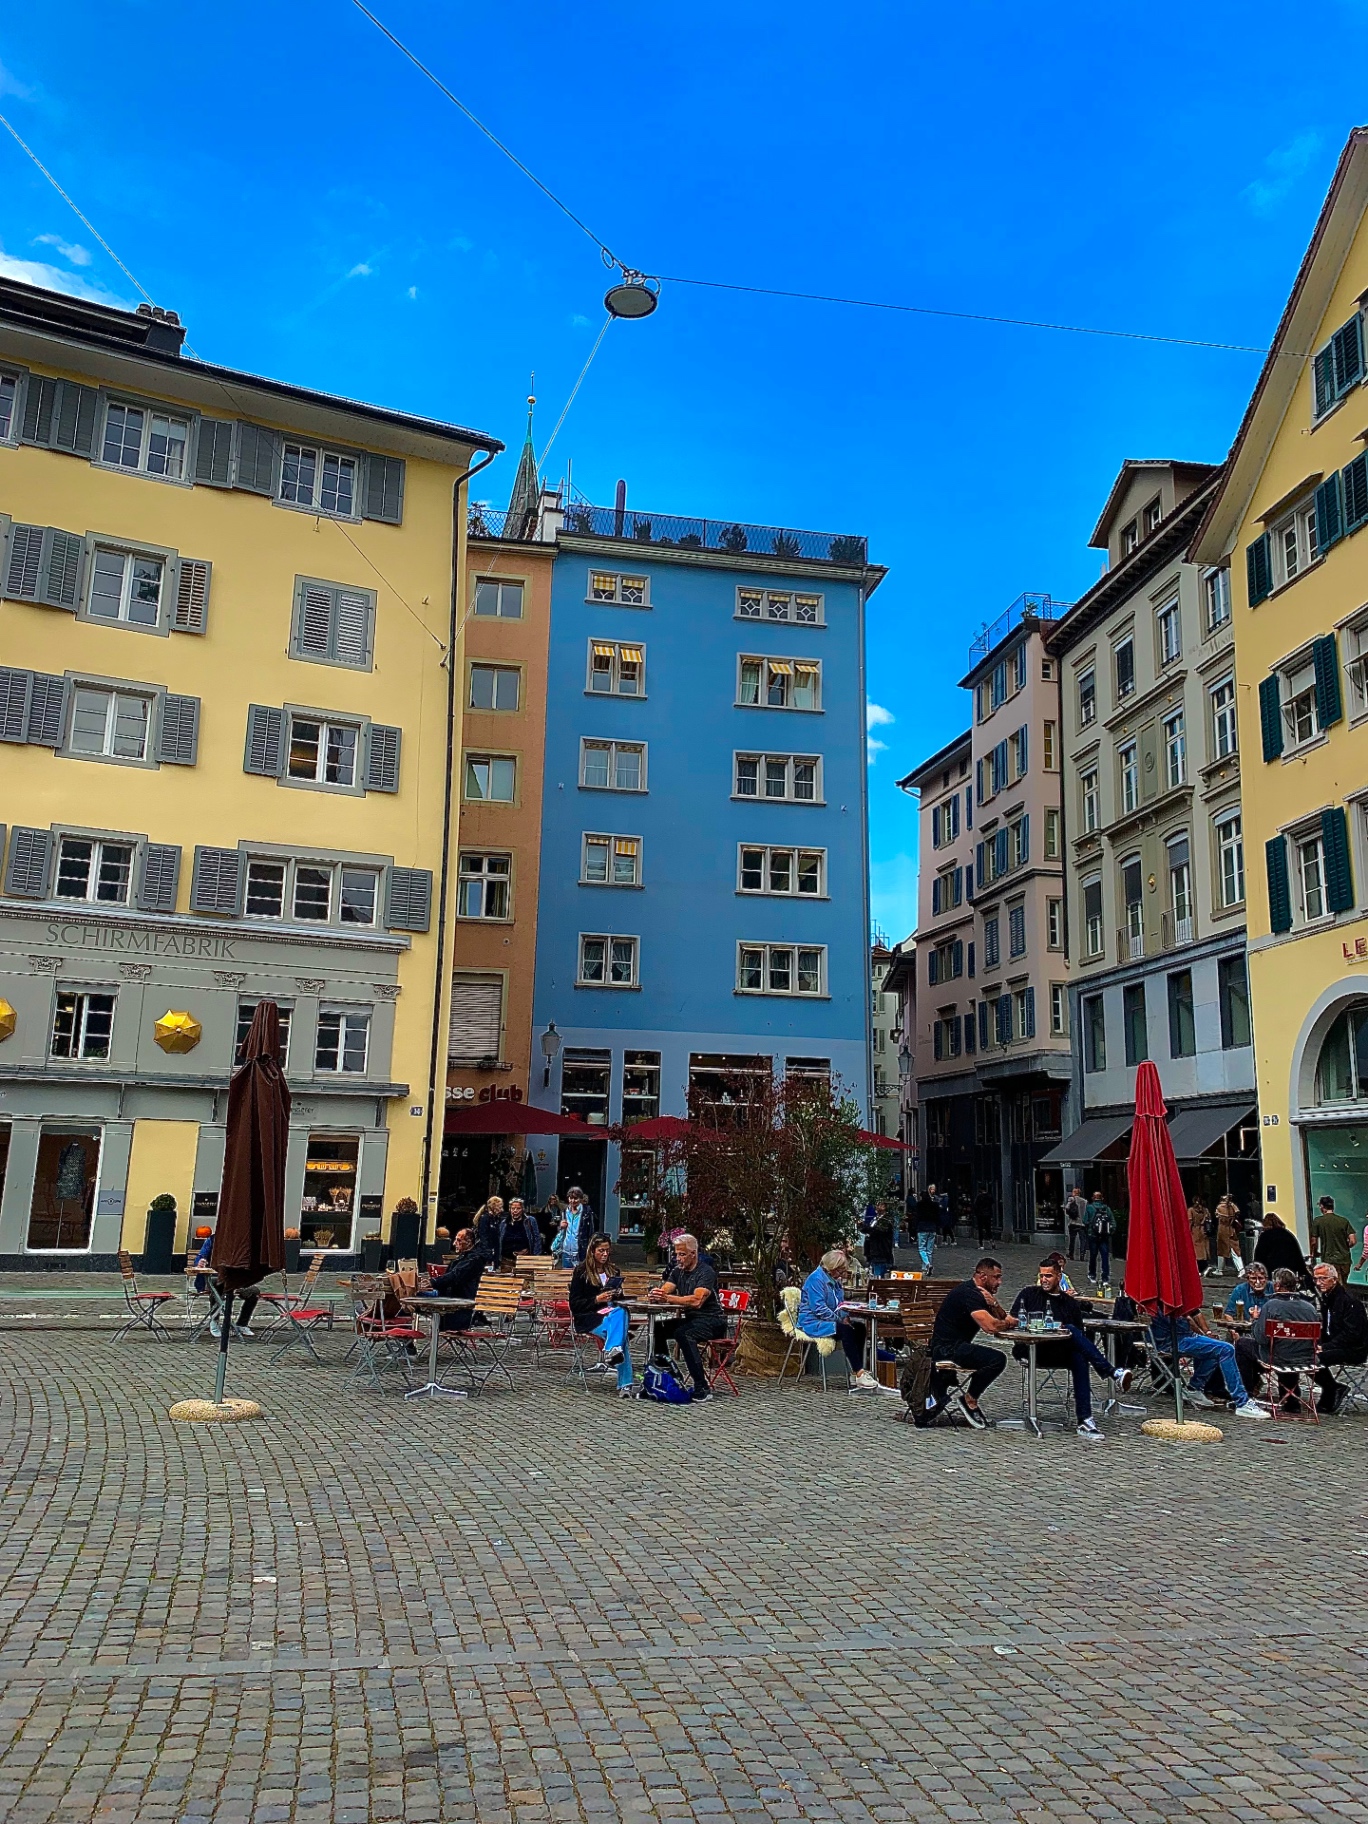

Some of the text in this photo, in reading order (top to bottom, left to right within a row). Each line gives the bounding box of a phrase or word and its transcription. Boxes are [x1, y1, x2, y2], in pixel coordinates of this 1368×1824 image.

[46, 924, 236, 958] SCHIRMFABRIK
[1342, 937, 1367, 958] LE
[479, 1083, 523, 1102] club
